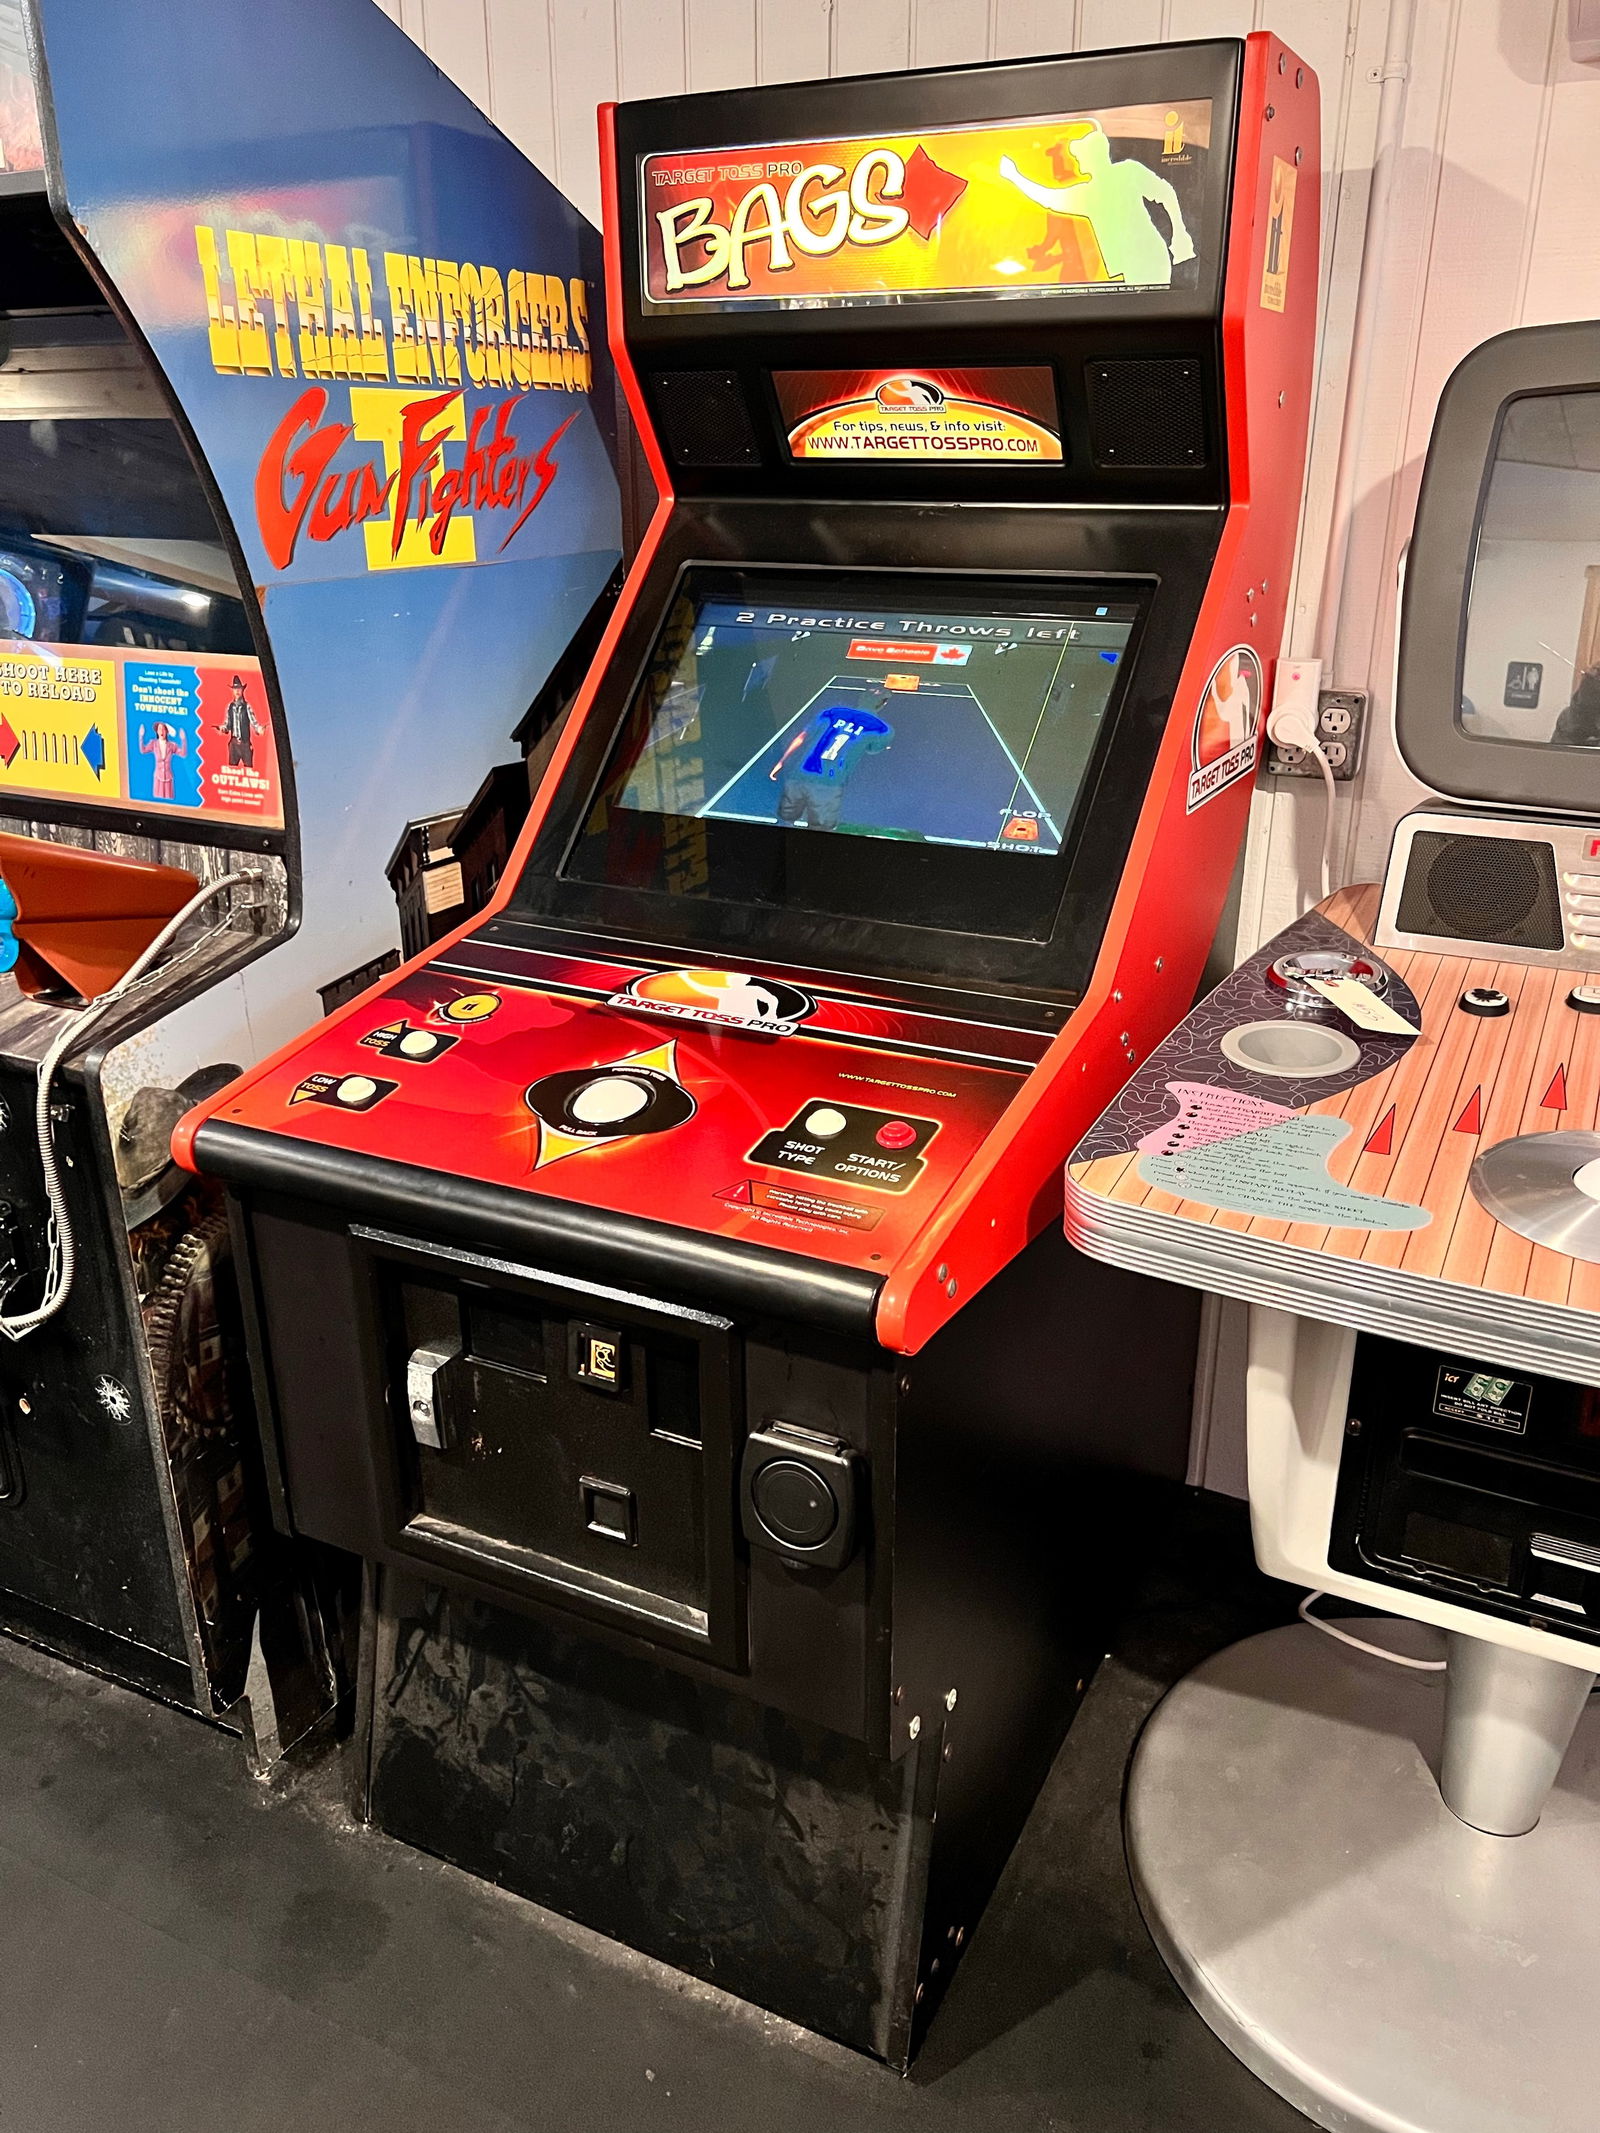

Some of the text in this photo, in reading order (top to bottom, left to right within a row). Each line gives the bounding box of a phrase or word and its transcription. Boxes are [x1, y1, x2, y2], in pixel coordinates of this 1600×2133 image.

[652, 161, 803, 186] TARGET TOSS PRO
[655, 149, 910, 294] BAGS
[195, 225, 593, 393] LETHAL ENFORCERS
[834, 421, 1006, 434] For tips, news, & info visit:
[807, 436, 1038, 453] WWW.TARGETTOSSPRO.COM
[735, 612, 1082, 641] 2 Practice Throws left
[55, 666, 102, 685] HERE
[1, 680, 96, 703] TO RELOAD
[139, 693, 183, 706] INNOCENT
[153, 686, 175, 696] shoot
[176, 688, 189, 697] the
[821, 733, 850, 761] 1
[1191, 743, 1255, 798] TARGET TOSS PRO
[212, 773, 270, 790] OUTLAWS!
[987, 841, 1040, 853] SHOT
[616, 996, 792, 1033] TARGET TOSS PRO
[363, 1036, 389, 1047] TOSS
[372, 1030, 398, 1041] HIGH
[301, 1082, 329, 1093] TOSS
[311, 1075, 337, 1086] LOW
[1177, 1088, 1264, 1107] INSTRUCTIONS
[558, 1124, 598, 1137] PULL BACK
[783, 1140, 826, 1155] SHOT
[777, 1150, 816, 1166] TYPE
[847, 1153, 907, 1172] START/
[834, 1162, 902, 1184] OPTIONS
